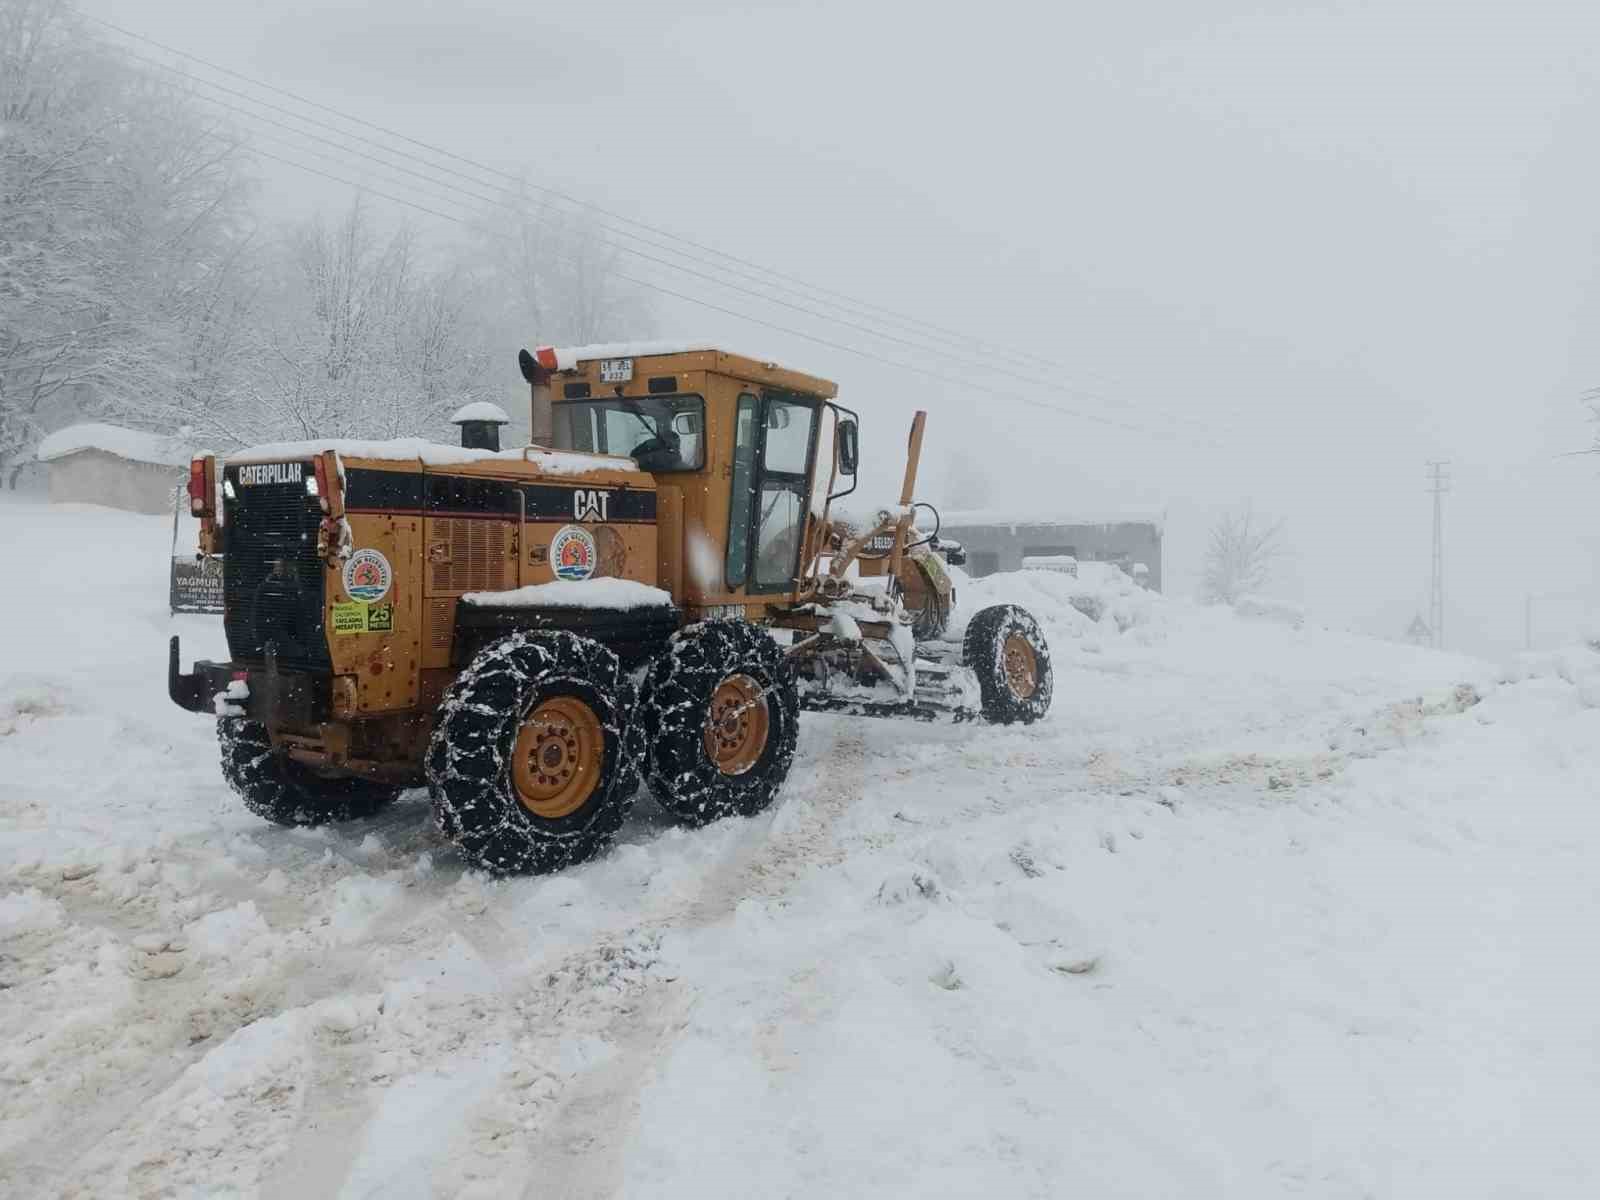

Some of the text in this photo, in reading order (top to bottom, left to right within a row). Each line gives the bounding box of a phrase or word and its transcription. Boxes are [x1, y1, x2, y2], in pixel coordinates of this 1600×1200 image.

[239, 463, 302, 485] CATERPILLAR
[574, 490, 610, 521] CAT
[369, 607, 389, 622] 25
